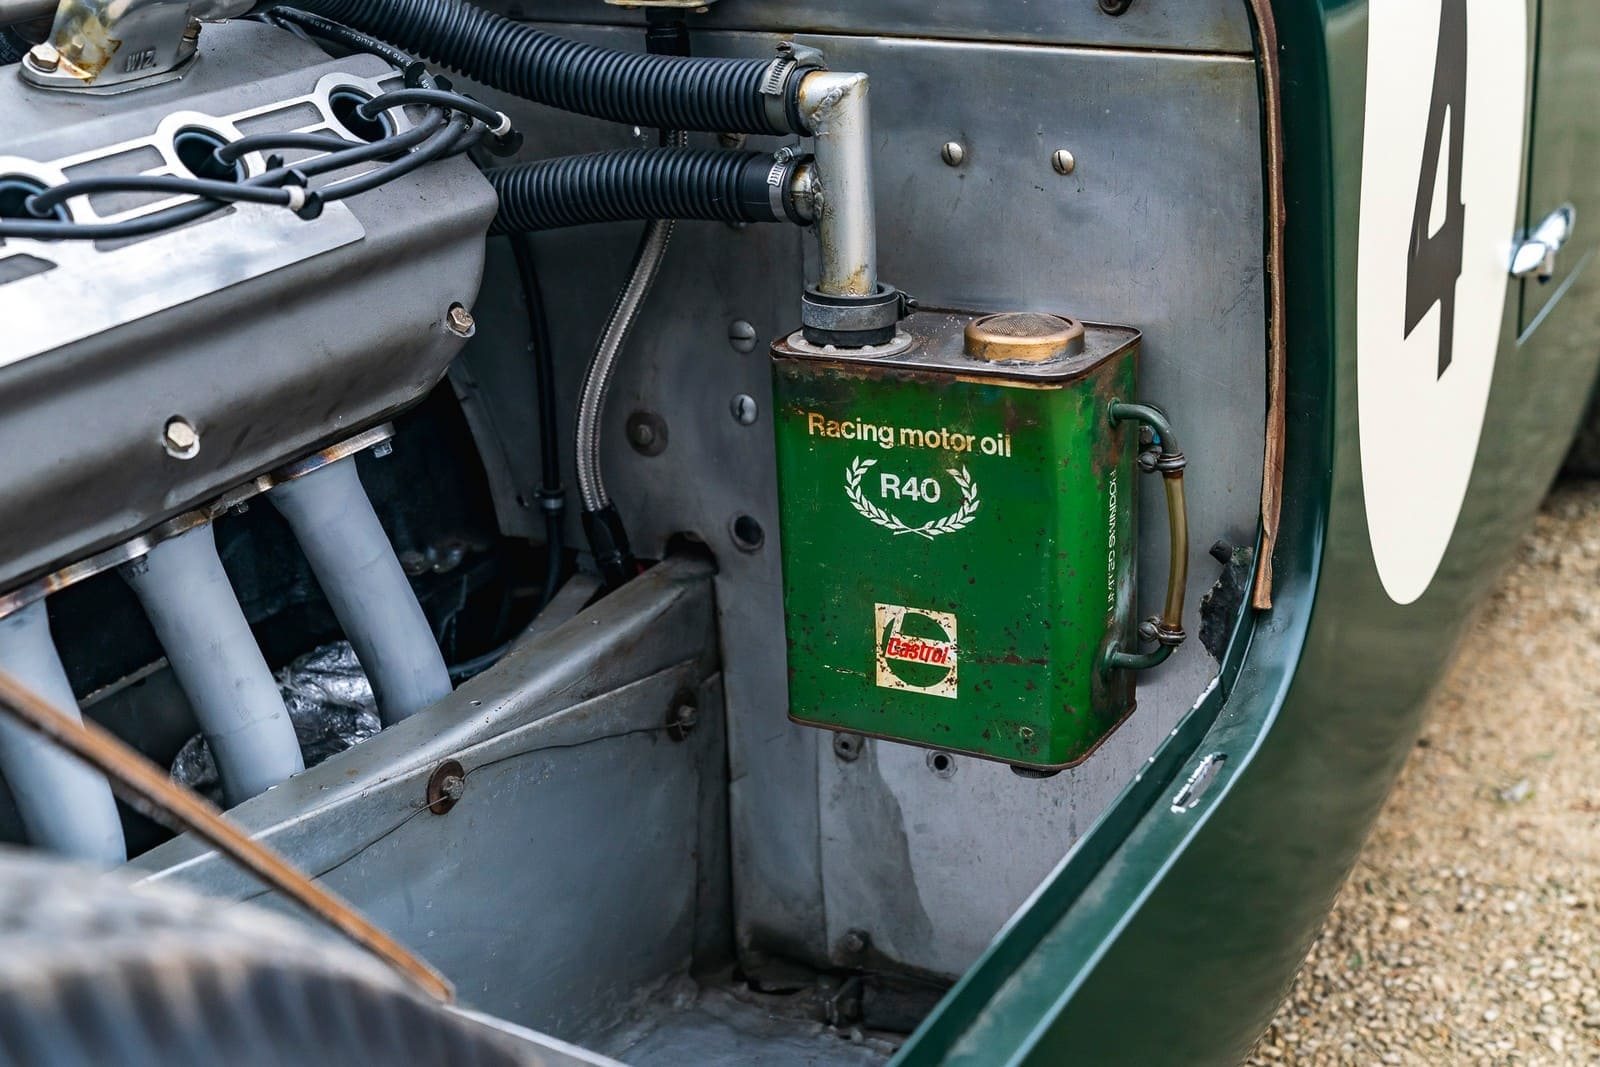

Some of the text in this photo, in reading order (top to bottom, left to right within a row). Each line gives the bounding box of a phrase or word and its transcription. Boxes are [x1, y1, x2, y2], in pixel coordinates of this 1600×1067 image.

[1404, 0, 1468, 382] 4
[808, 412, 1012, 457] Racing motor oil
[881, 473, 941, 504] R40
[887, 637, 949, 665] Castrol
